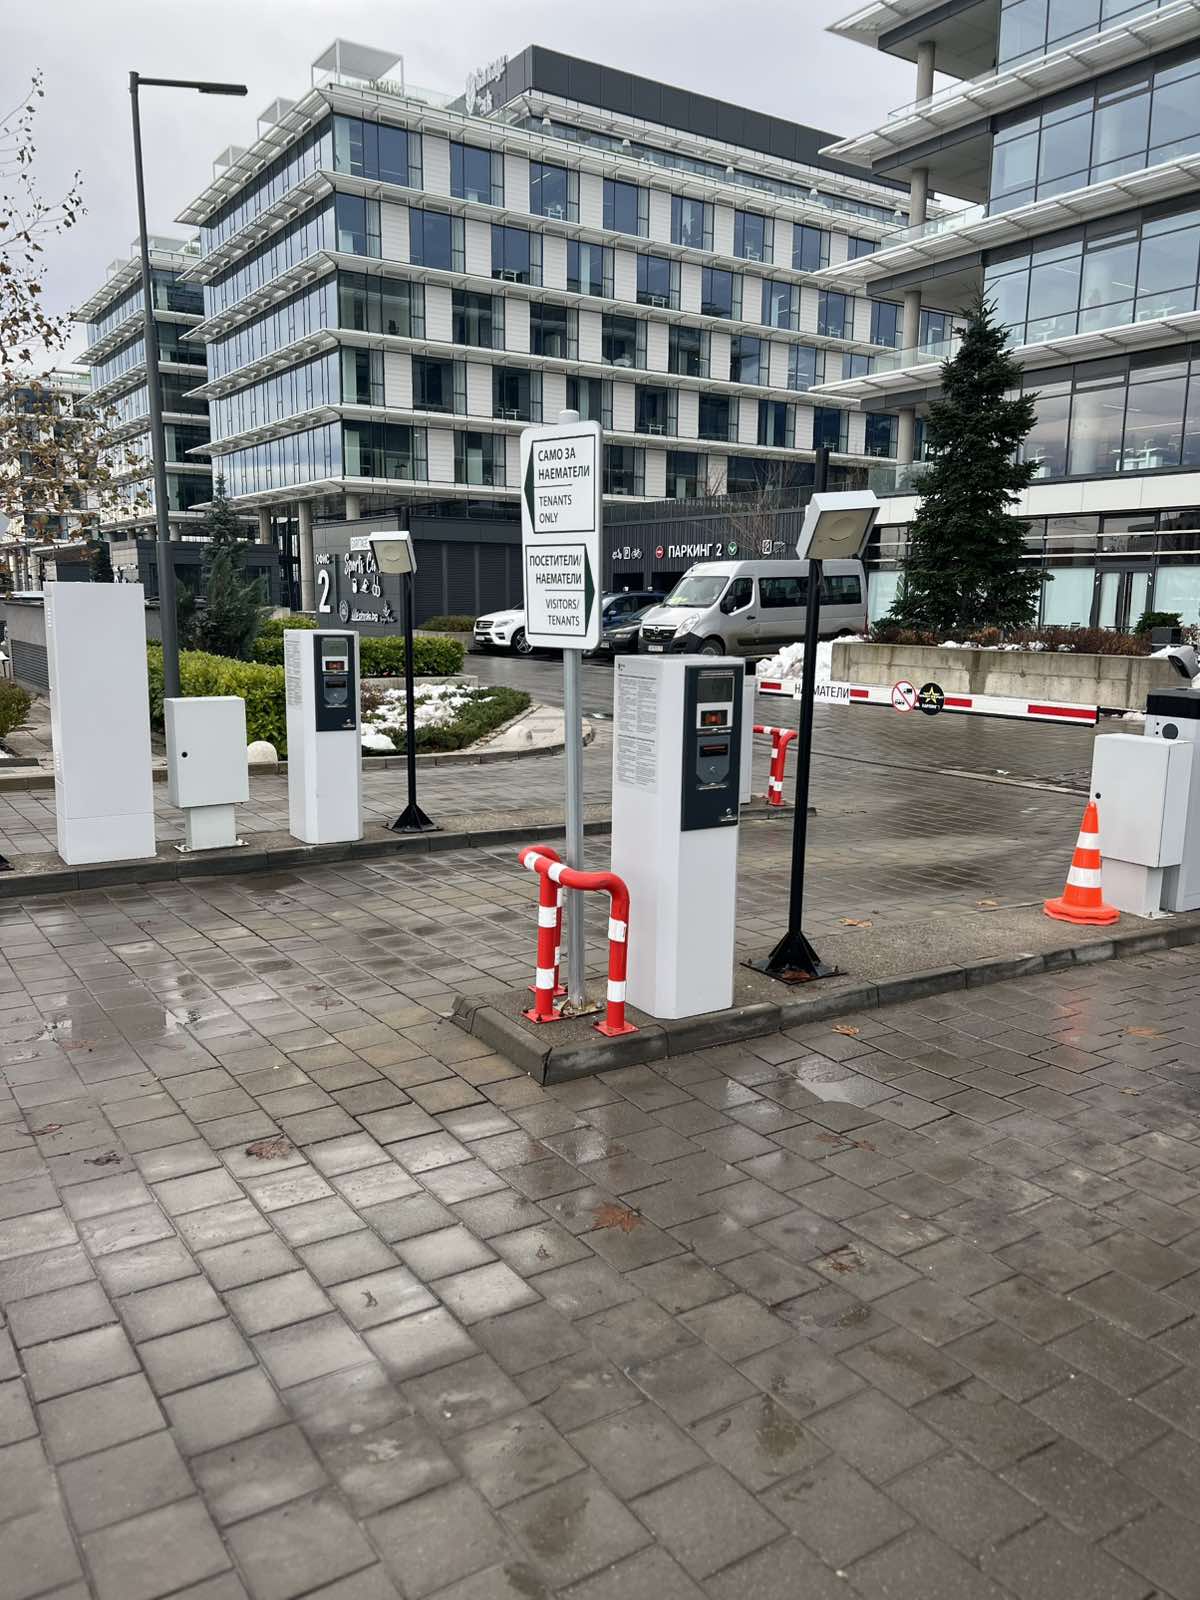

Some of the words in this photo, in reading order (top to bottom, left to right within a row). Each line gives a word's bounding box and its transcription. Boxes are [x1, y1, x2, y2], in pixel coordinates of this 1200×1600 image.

[538, 449, 564, 462] САМО
[565, 448, 576, 459] ЗА
[538, 464, 590, 480] НАЕМАТЕЛИ
[539, 495, 572, 507] TENANTS
[539, 513, 559, 524] ONLY
[668, 543, 713, 558] ПАРКИНГ
[716, 543, 722, 557] 2
[530, 552, 582, 567] ПОСЕТИТЕЛИ/
[536, 572, 582, 585] НАЕМАТЕЛИ
[318, 569, 331, 613] 2
[545, 599, 579, 610] VISITORS/
[548, 615, 580, 627] TENANTS
[794, 683, 850, 699] НМАТЕЛИ
